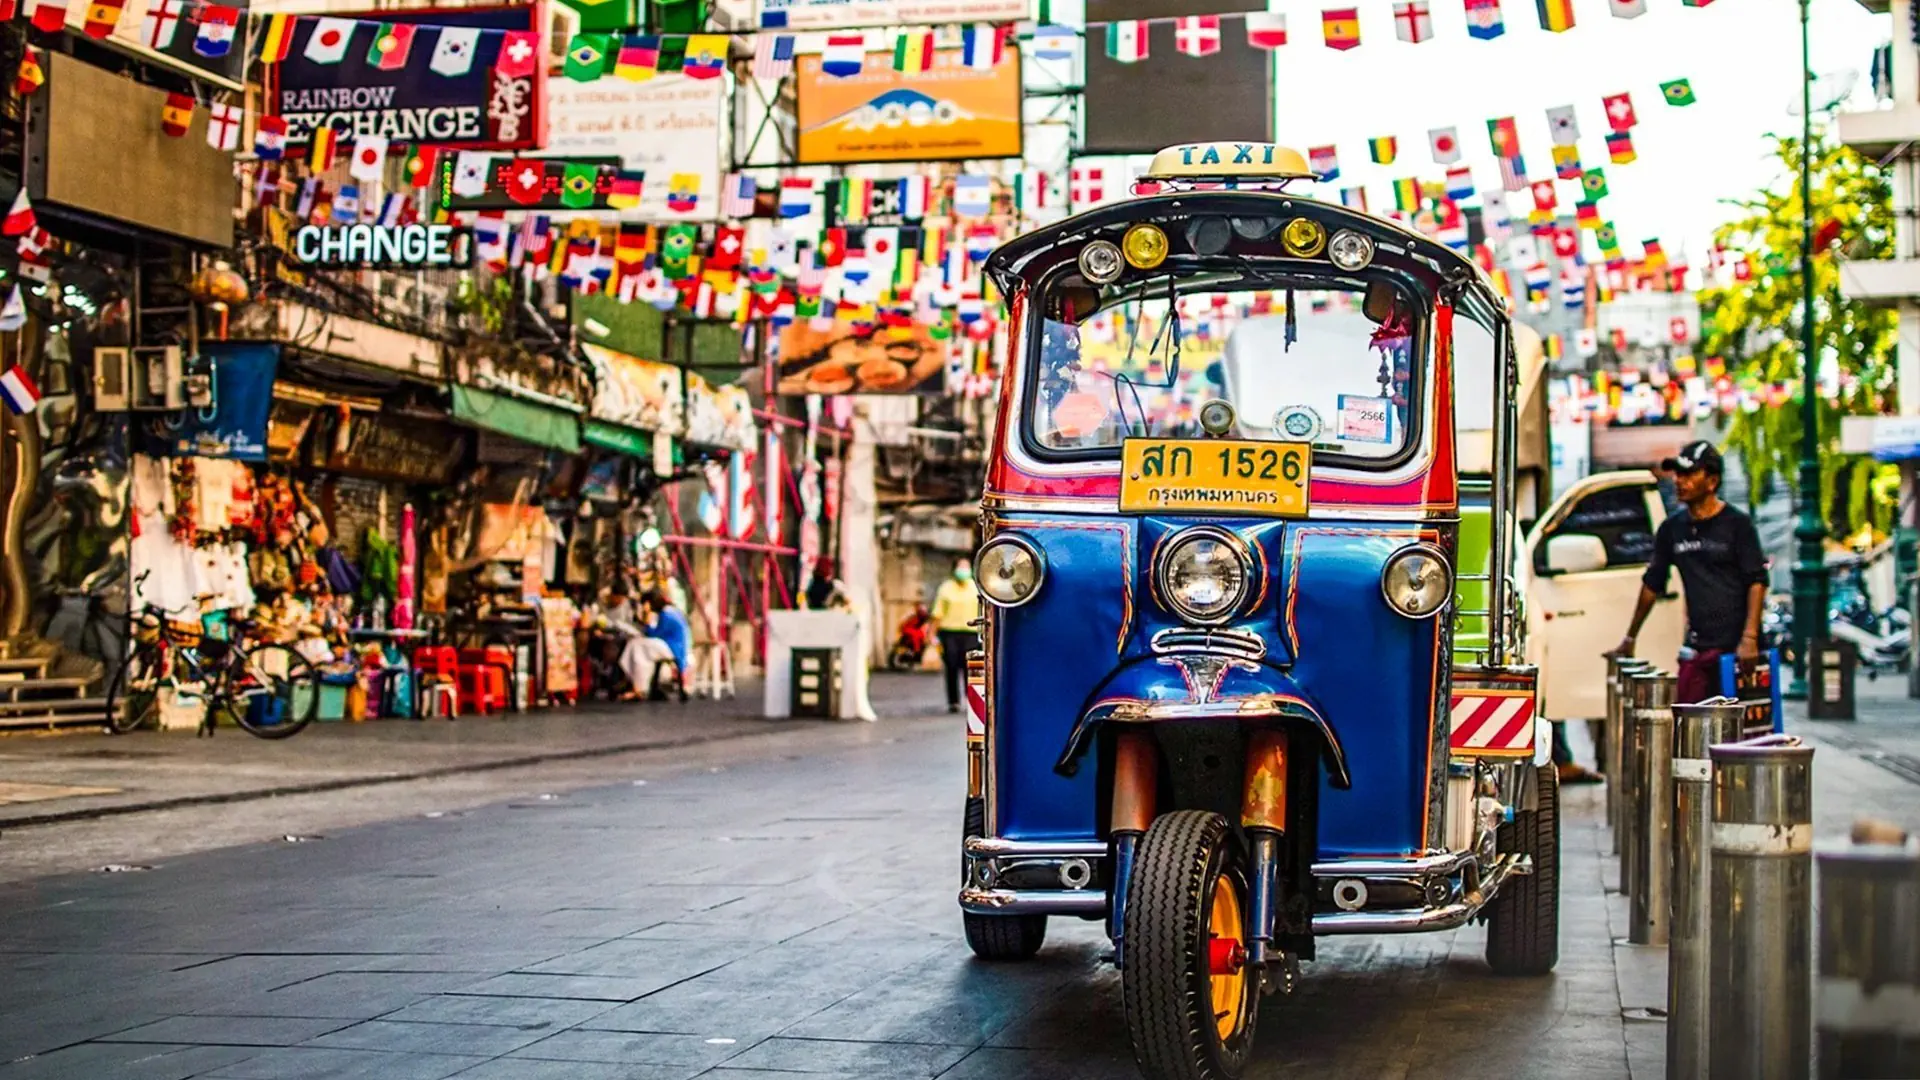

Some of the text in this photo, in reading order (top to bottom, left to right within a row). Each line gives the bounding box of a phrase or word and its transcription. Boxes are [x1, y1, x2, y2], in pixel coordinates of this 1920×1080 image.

[282, 86, 396, 110] RAINBOW
[281, 106, 480, 145] EXCHANGE
[1178, 144, 1275, 165] TAXI
[1360, 410, 1385, 421] 2566
[1142, 444, 1301, 482] สก 1526
[1148, 488, 1278, 506] กรุงเทพมหานคร
